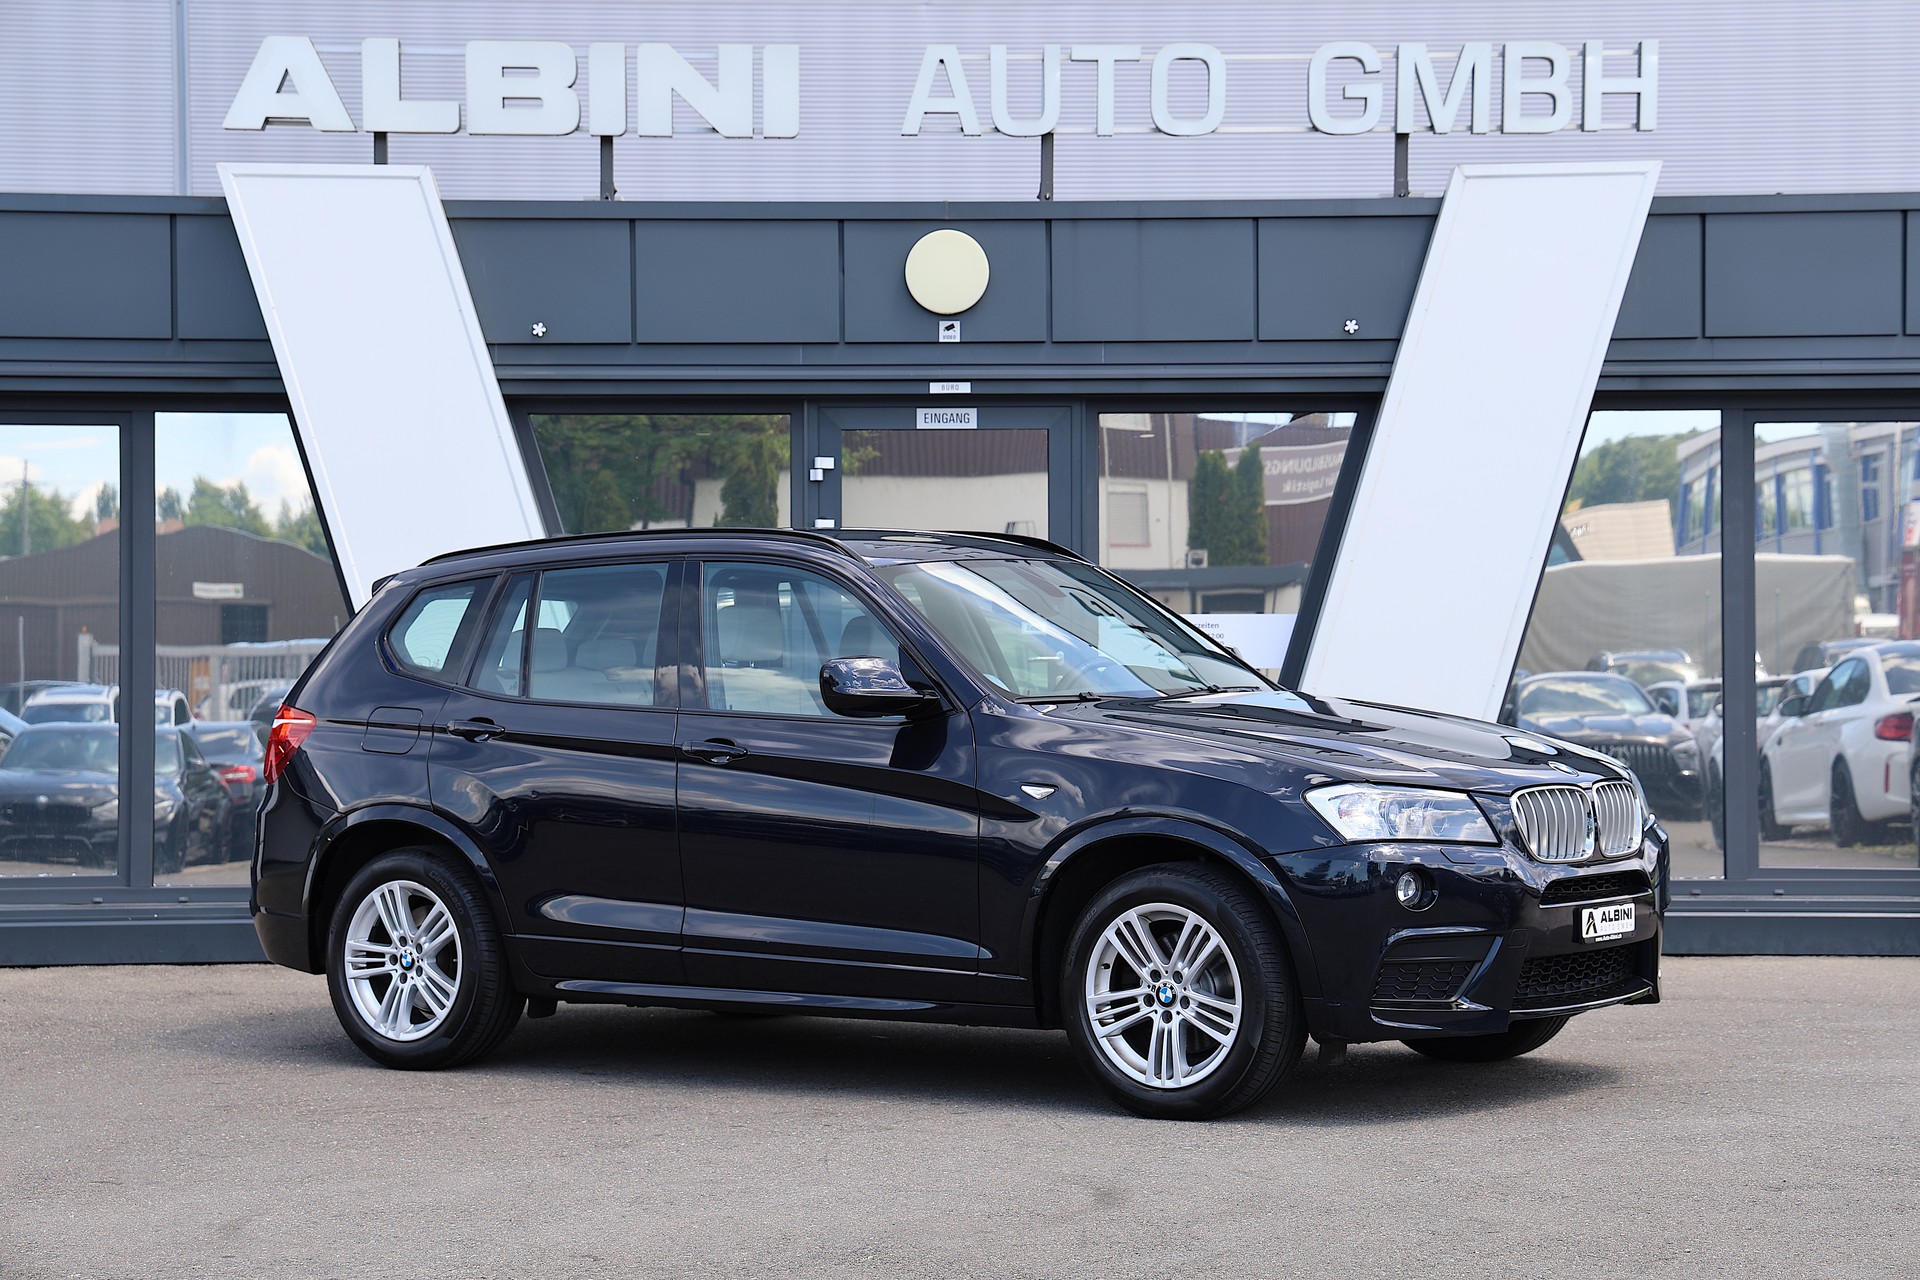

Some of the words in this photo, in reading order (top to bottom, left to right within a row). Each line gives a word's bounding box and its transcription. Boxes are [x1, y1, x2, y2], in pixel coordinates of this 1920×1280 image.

[222, 35, 800, 139] ALBINI
[901, 41, 1227, 138] AUTO
[1307, 37, 1660, 135] GMBH
[924, 412, 970, 424] EINGANG
[1600, 907, 1632, 923] ALBINI
